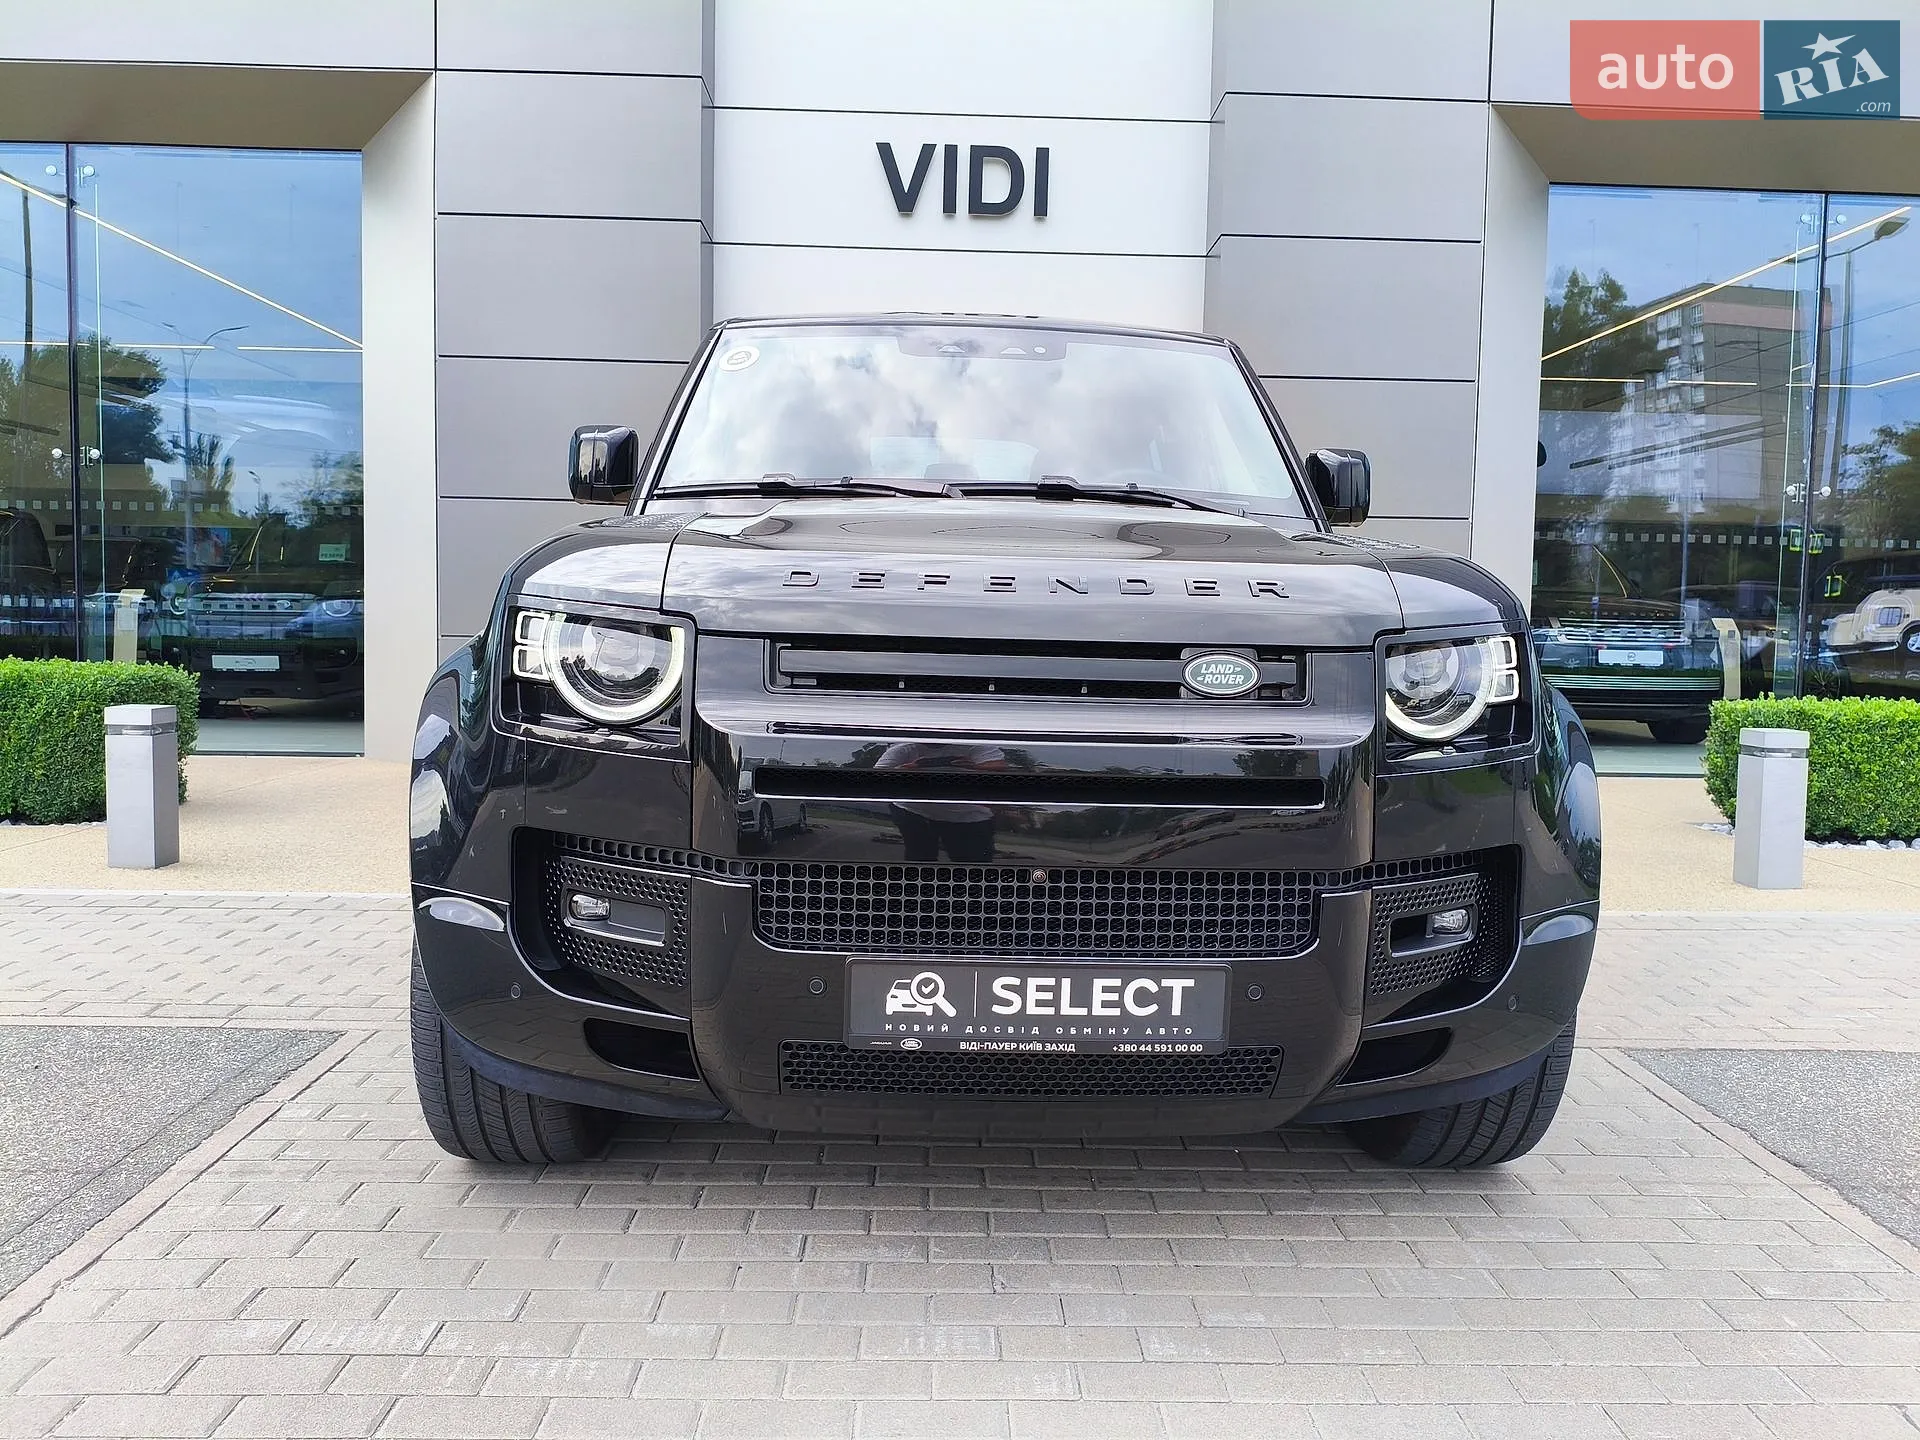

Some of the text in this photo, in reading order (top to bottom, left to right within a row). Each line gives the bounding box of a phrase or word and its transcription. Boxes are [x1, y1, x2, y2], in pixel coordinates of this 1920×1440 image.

[876, 142, 1050, 218] VIDI
[782, 569, 1290, 598] DEFENDER
[1200, 663, 1234, 674] LAND
[1203, 674, 1245, 685] ROVER
[991, 976, 1196, 1017] SELECT
[885, 1023, 1193, 1036] НОВИЙ ДОСВІД ОБМІНУ АВТО
[959, 1041, 1076, 1053] ВІДІ-ПАУЕР КИЇВ ЗАХІД
[1112, 1044, 1203, 1053] +380 44 591 00 00
